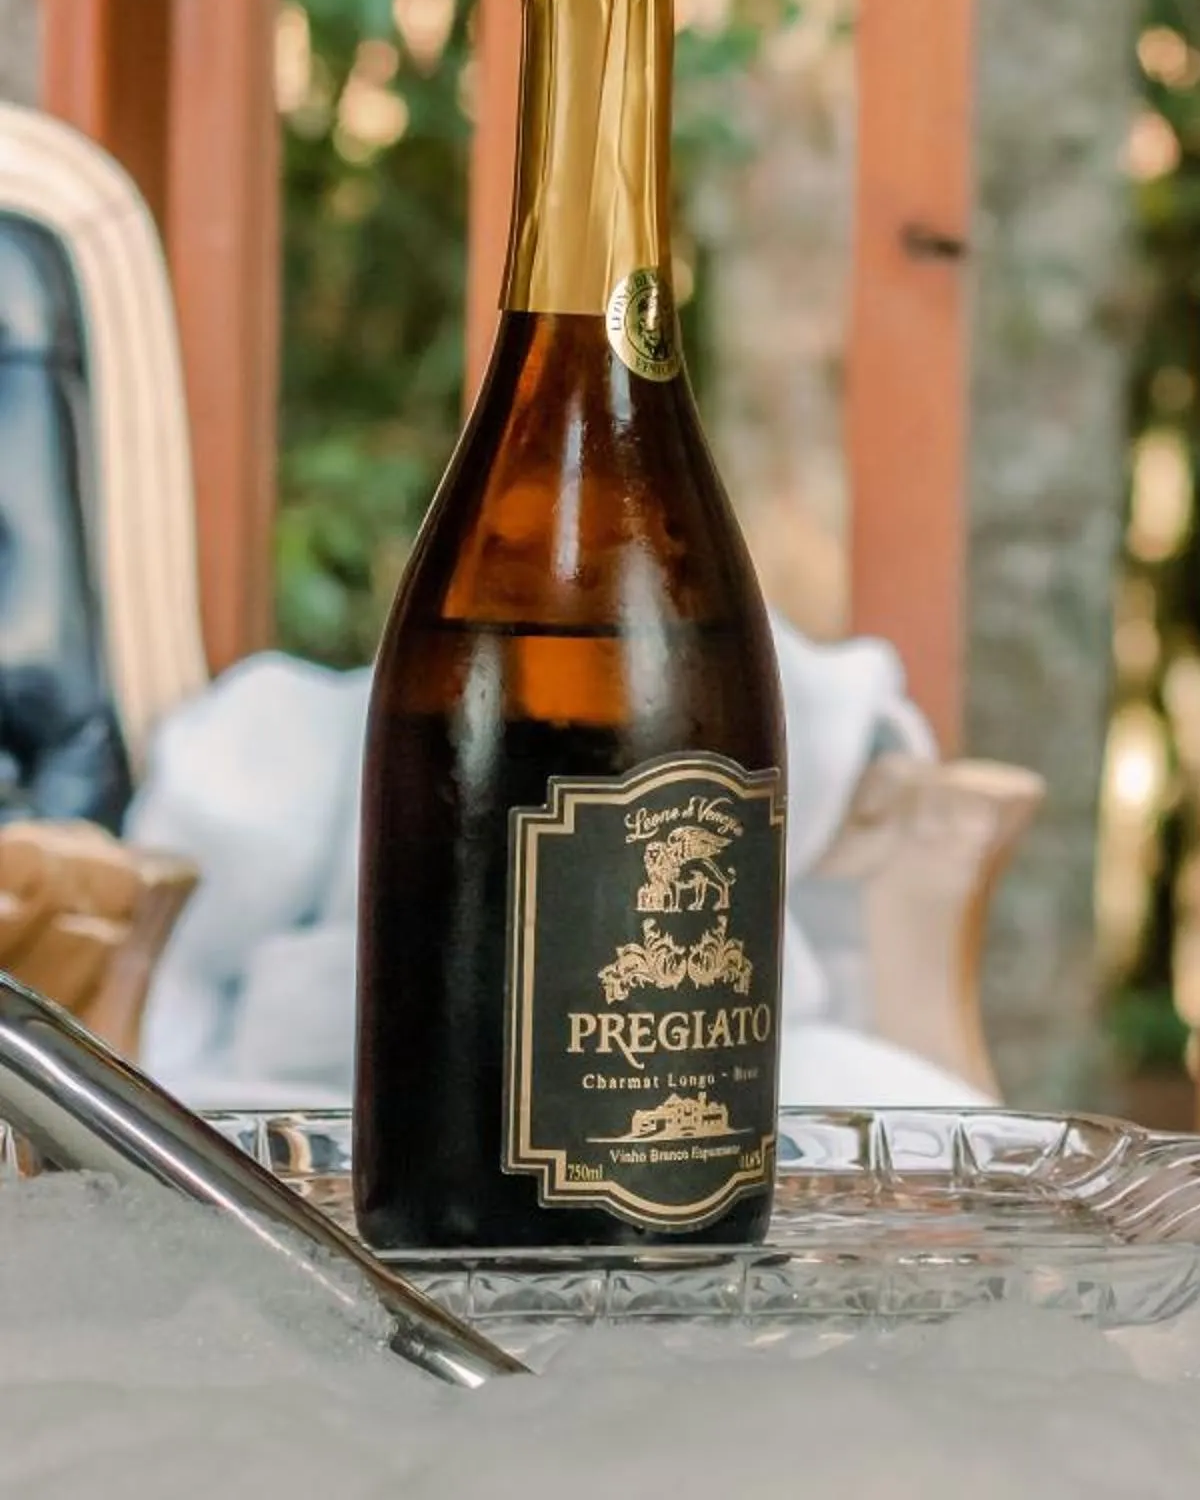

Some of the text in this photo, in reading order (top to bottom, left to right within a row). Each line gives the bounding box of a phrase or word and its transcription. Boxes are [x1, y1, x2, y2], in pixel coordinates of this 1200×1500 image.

[624, 807, 680, 843] Leone
[566, 1003, 771, 1069] PREGIATO
[581, 1073, 660, 1090] Charmat
[667, 1071, 716, 1089] Longo
[609, 1149, 647, 1164] Vinho
[567, 1163, 603, 1181] 750ml
